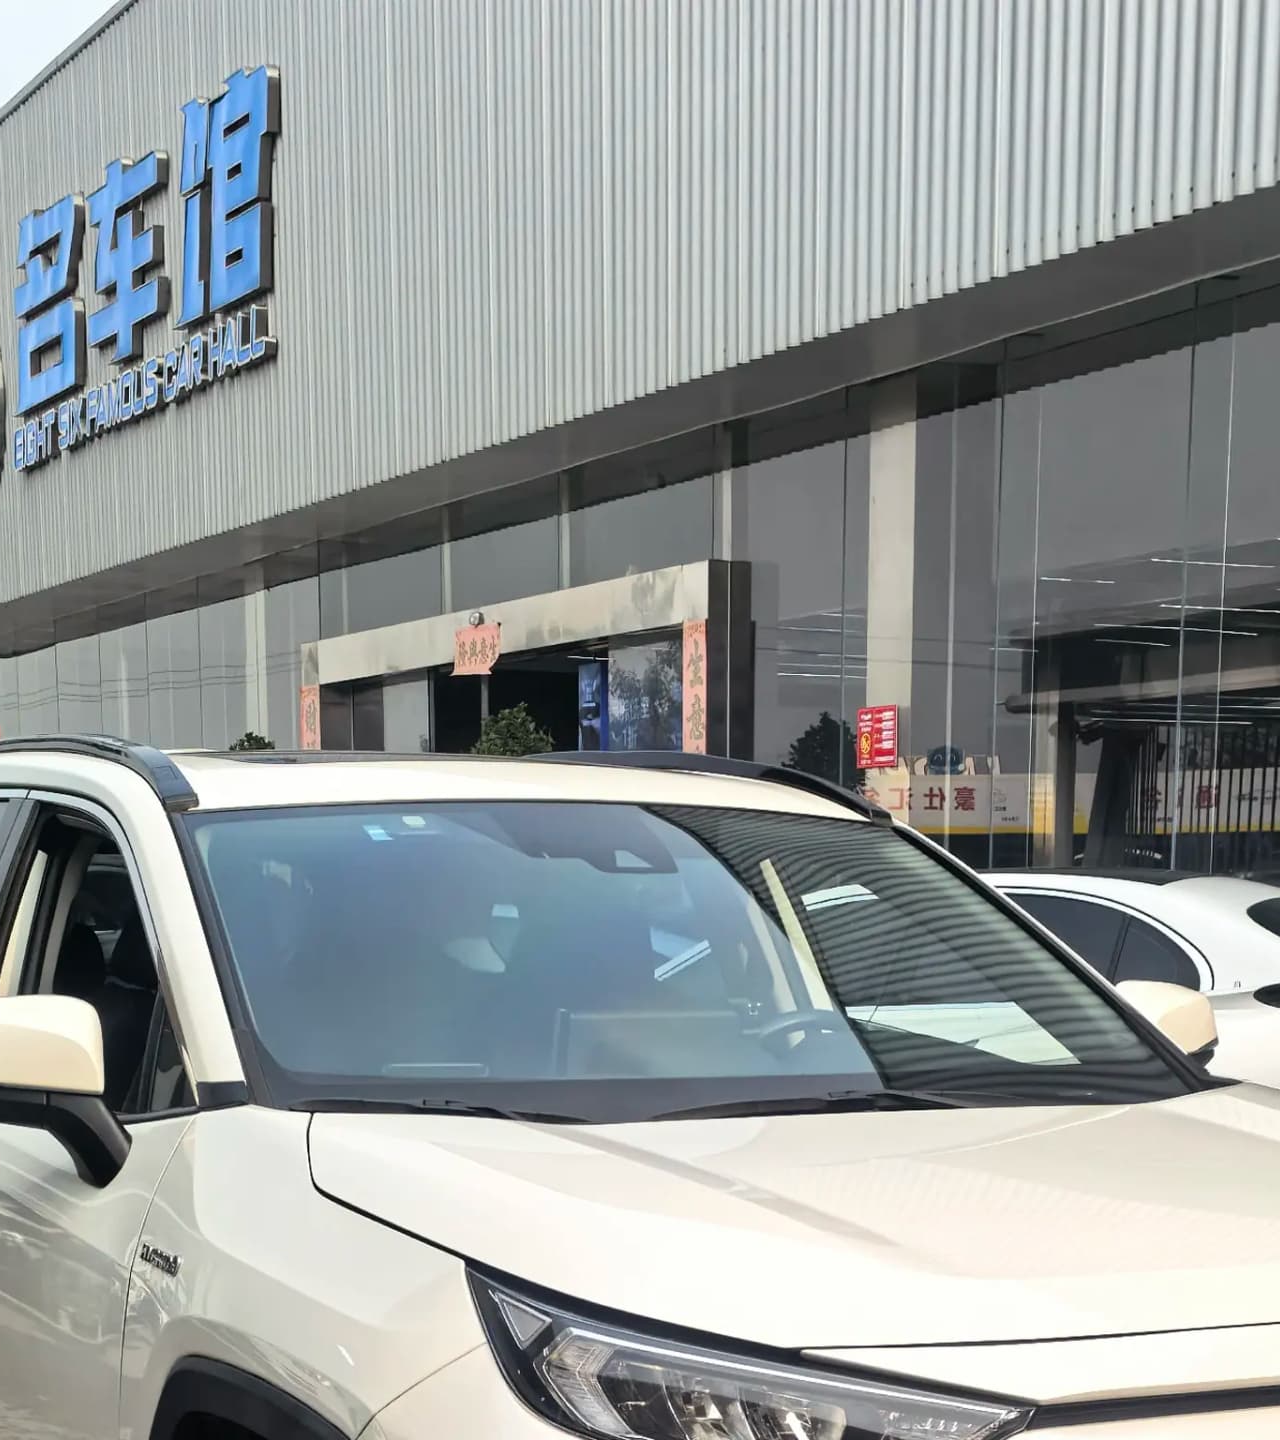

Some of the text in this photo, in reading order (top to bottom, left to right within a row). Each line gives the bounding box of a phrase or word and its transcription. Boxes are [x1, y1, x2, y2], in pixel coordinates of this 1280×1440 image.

[14, 64, 278, 418] 名车馆
[14, 303, 266, 472] EIGHT SIX FAMOUS CAR HALL
